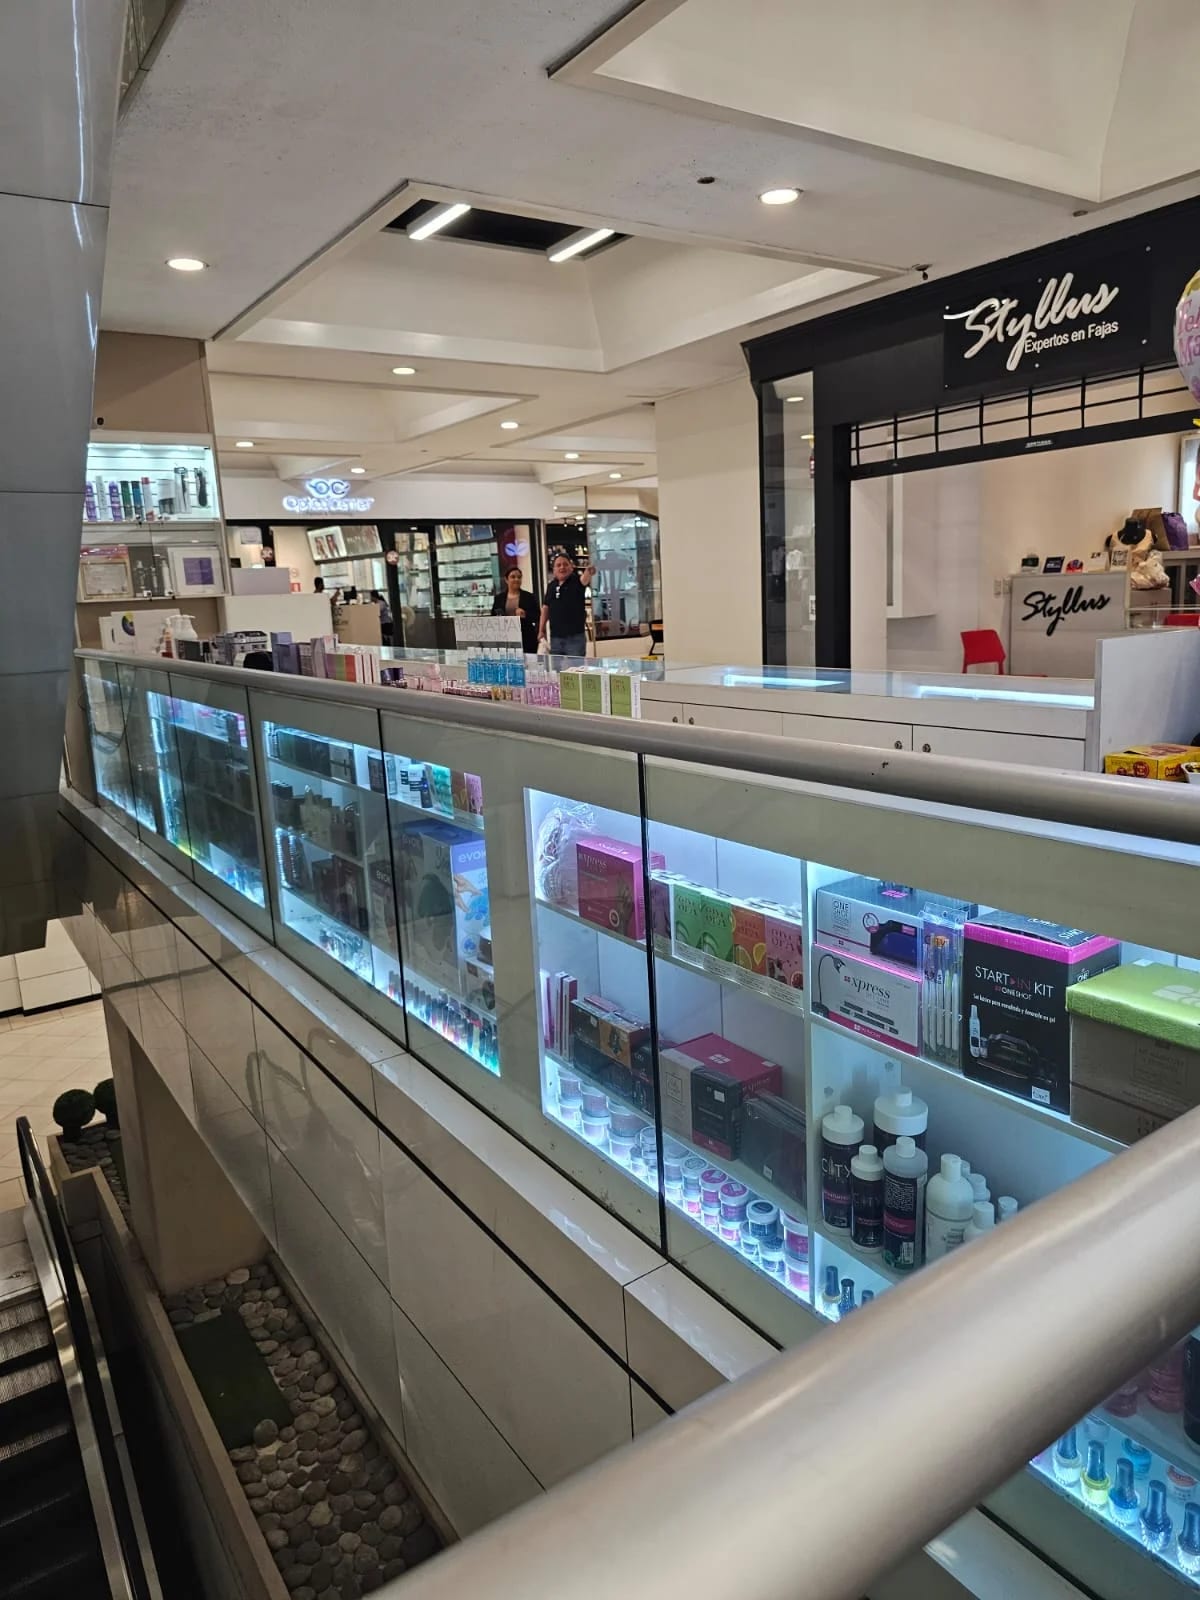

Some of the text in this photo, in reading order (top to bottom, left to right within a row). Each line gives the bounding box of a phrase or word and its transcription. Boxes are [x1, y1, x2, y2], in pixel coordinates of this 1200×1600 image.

[944, 272, 1119, 371] Styllus
[1024, 321, 1119, 353] Expertos en Fajas
[1021, 585, 1111, 636] Styllus
[975, 966, 1010, 985] START
[1034, 982, 1055, 998] KIT
